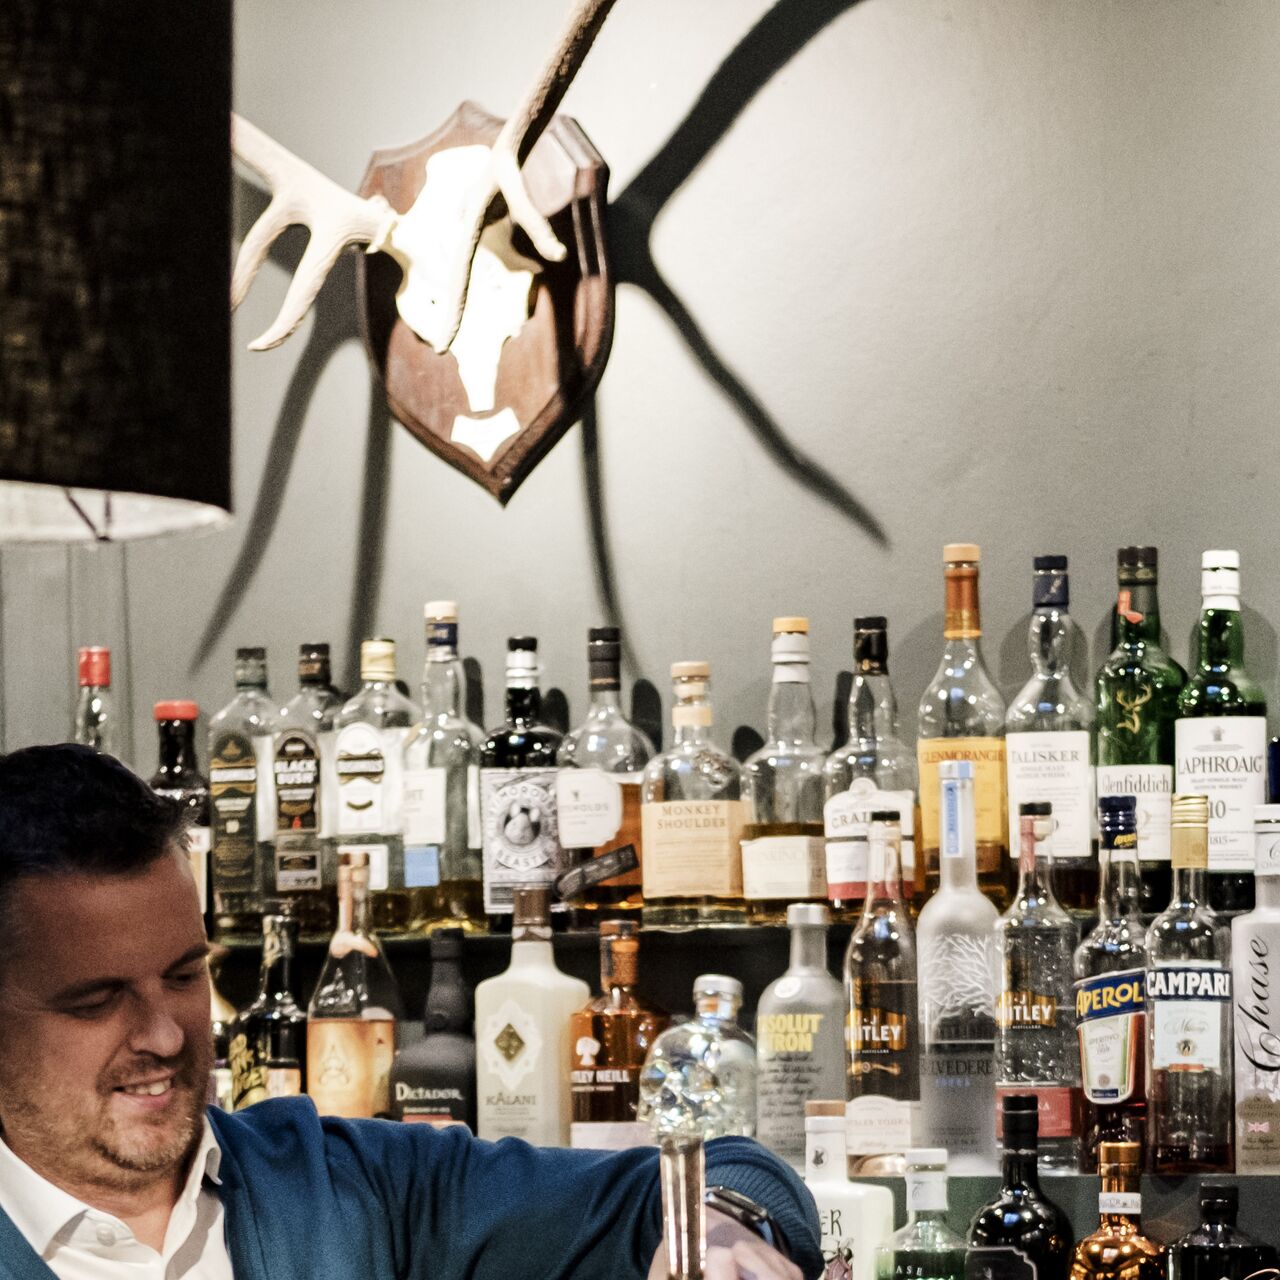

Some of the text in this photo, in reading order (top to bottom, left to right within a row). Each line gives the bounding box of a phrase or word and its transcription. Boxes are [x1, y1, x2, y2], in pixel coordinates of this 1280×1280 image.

[923, 750, 1003, 763] GLENMORANGIE
[1011, 750, 1080, 763] TALISKER
[1178, 755, 1263, 774] LAPHROAIG
[274, 758, 317, 773] BLACK
[1102, 774, 1171, 794] Glenfiddich
[661, 804, 720, 816] MONKEY
[1208, 800, 1226, 819] 10
[656, 818, 726, 831] SHOULDER
[1147, 971, 1231, 997] CAMPARI
[1076, 982, 1143, 1017] APEROL
